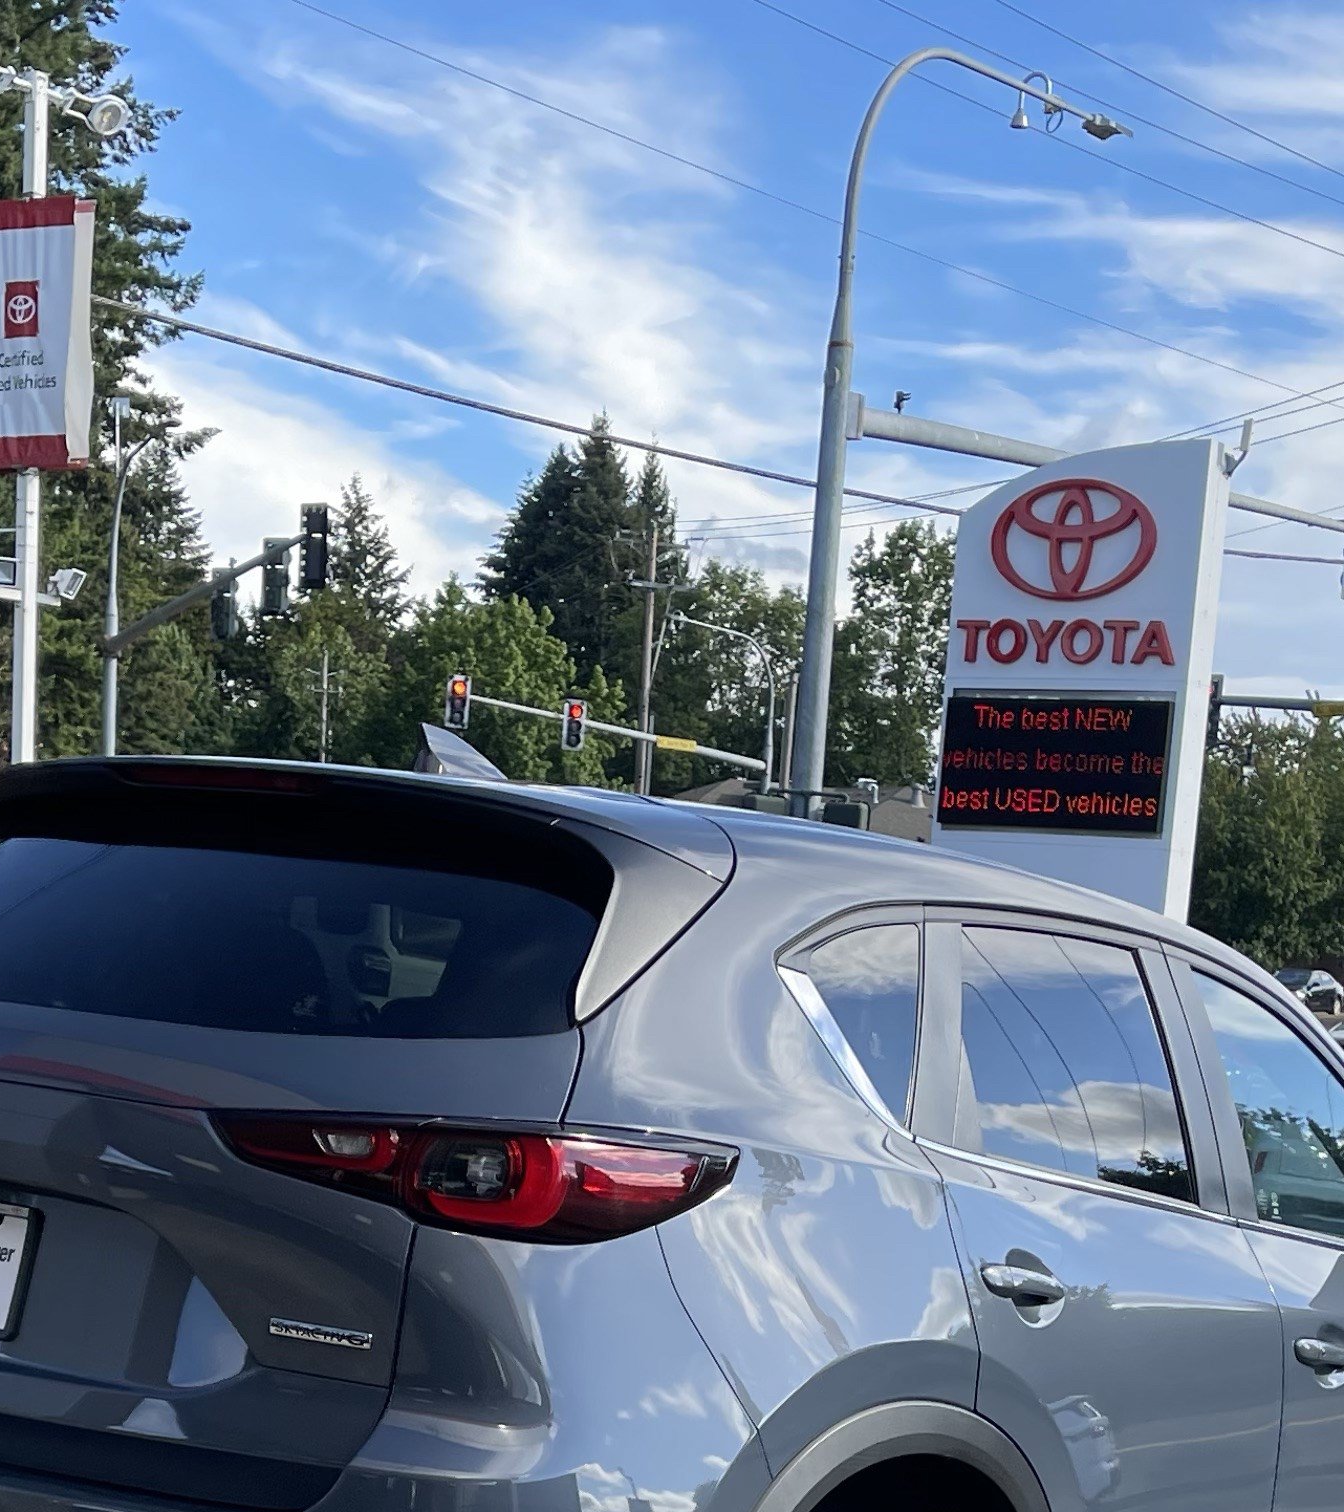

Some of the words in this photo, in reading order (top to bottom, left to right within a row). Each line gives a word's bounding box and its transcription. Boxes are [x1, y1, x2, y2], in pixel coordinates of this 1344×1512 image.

[957, 618, 1175, 666] TOYOTA
[974, 705, 1015, 729] The
[1021, 707, 1070, 732] best
[1075, 707, 1133, 732] NEW
[942, 746, 1029, 771] vehicles
[1036, 748, 1125, 774] become
[1131, 751, 1165, 775] the
[942, 785, 990, 810] best
[994, 787, 1061, 813] USED
[1066, 791, 1157, 817] vehicles
